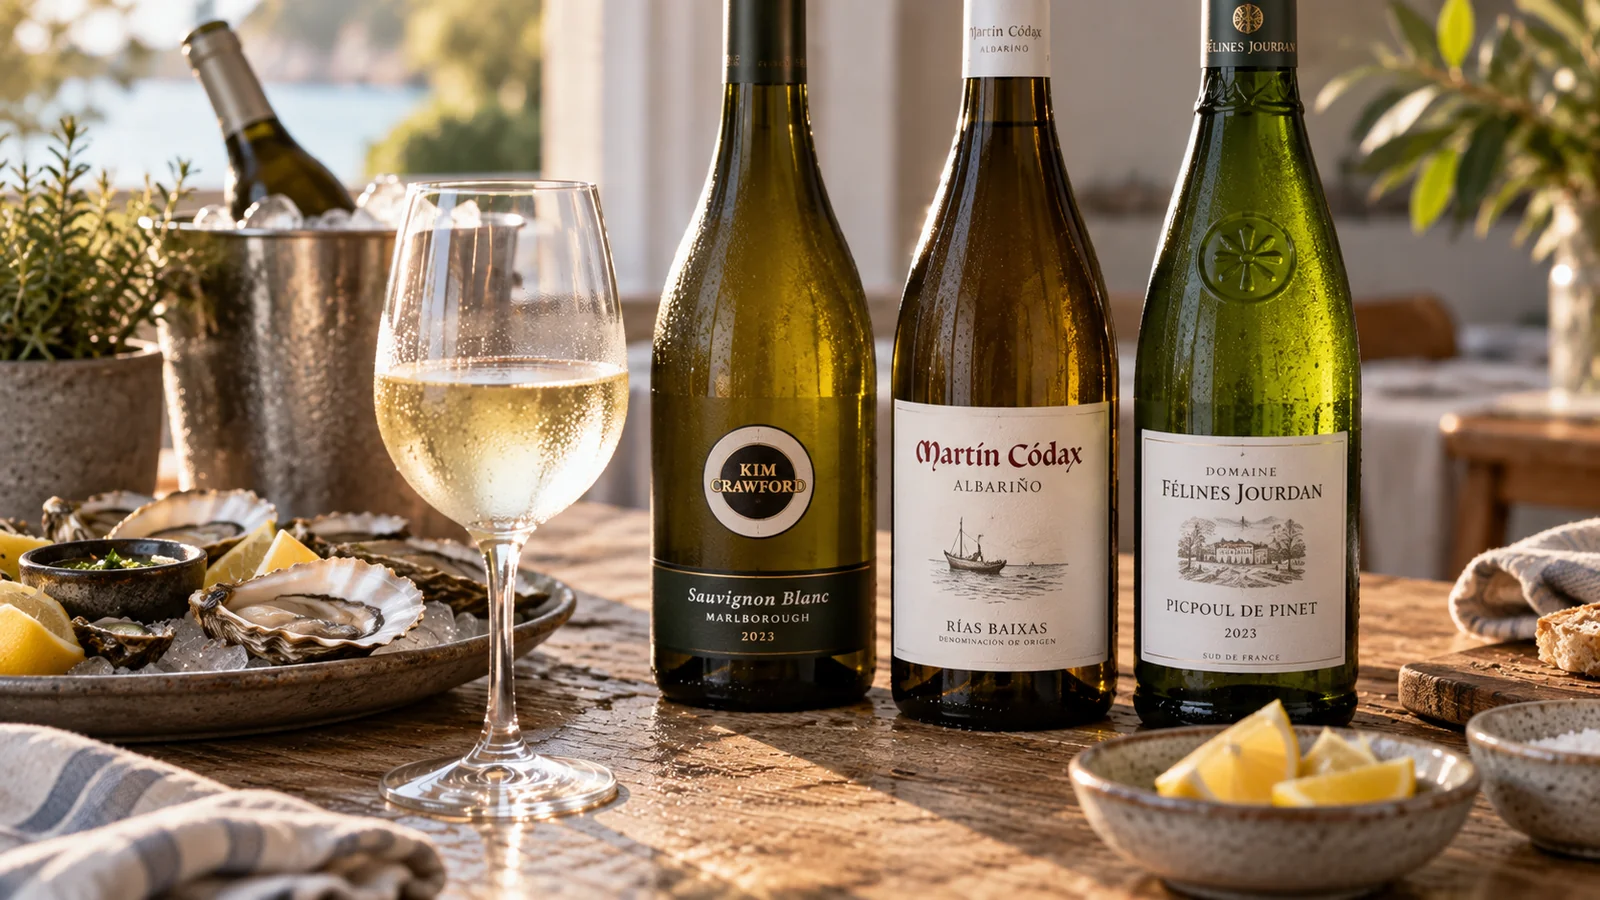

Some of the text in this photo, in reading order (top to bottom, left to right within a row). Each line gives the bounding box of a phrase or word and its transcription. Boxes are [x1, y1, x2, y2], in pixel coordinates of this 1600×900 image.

[916, 440, 1083, 473] Martín Códax
[740, 463, 776, 476] KIM
[1206, 467, 1277, 477] DOMAINE
[710, 478, 806, 494] CRAWFORD
[953, 478, 1042, 493] ALBARIÑO
[1162, 480, 1322, 505] FÉLINES JOURDAN
[687, 587, 829, 610] Sauvignon Blanc
[1166, 598, 1318, 617] PICPOUL DE PINET
[706, 612, 810, 623] MARLBOROUGH
[947, 619, 1047, 635] RÍAS BAIXAS
[1224, 627, 1257, 639] 2023
[741, 631, 775, 642] 2023
[1023, 638, 1056, 646] ORIGEN
[1202, 652, 1281, 662] SUD DE FRANCE
